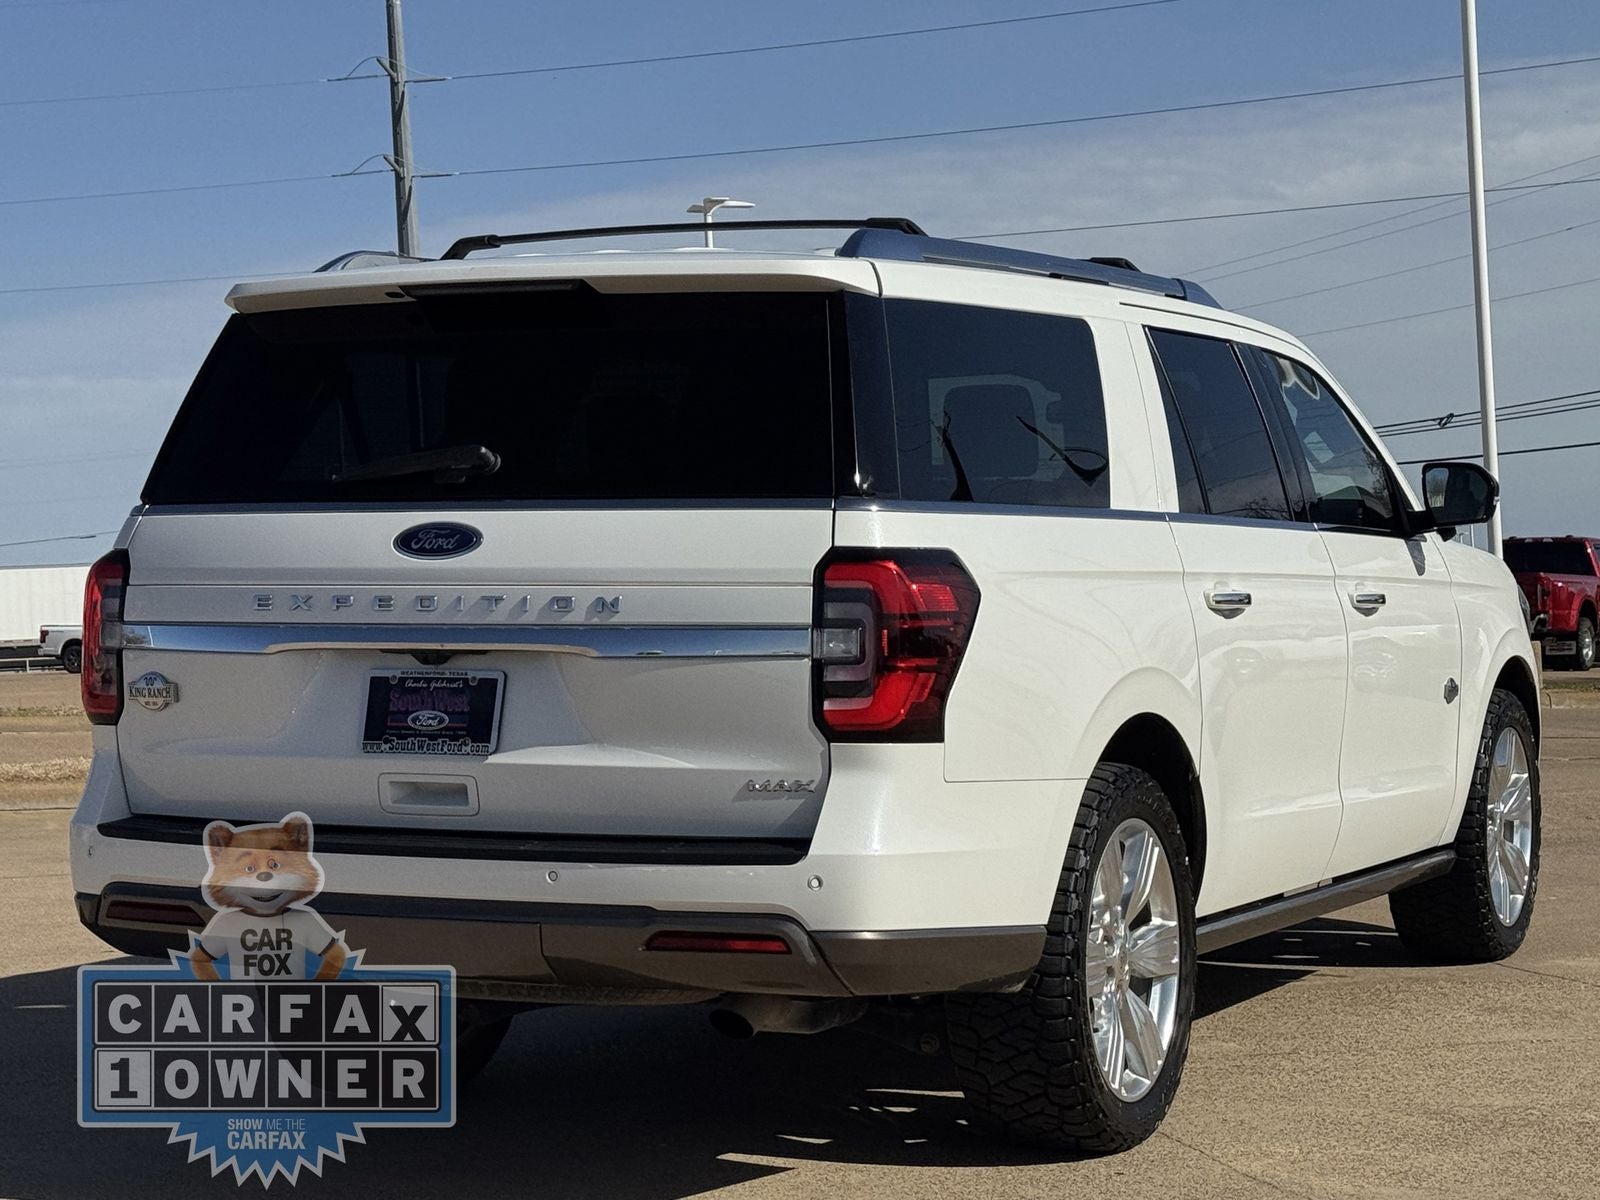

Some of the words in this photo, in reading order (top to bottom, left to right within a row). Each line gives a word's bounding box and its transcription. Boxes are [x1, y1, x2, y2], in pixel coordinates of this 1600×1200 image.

[411, 528, 460, 550] Ford
[253, 594, 623, 613] EXPEDITION
[129, 685, 147, 698] KING
[147, 686, 171, 699] RANCH
[416, 713, 439, 727] Ford
[362, 737, 490, 755] www.SouthWestFord.com
[747, 779, 816, 793] MAX
